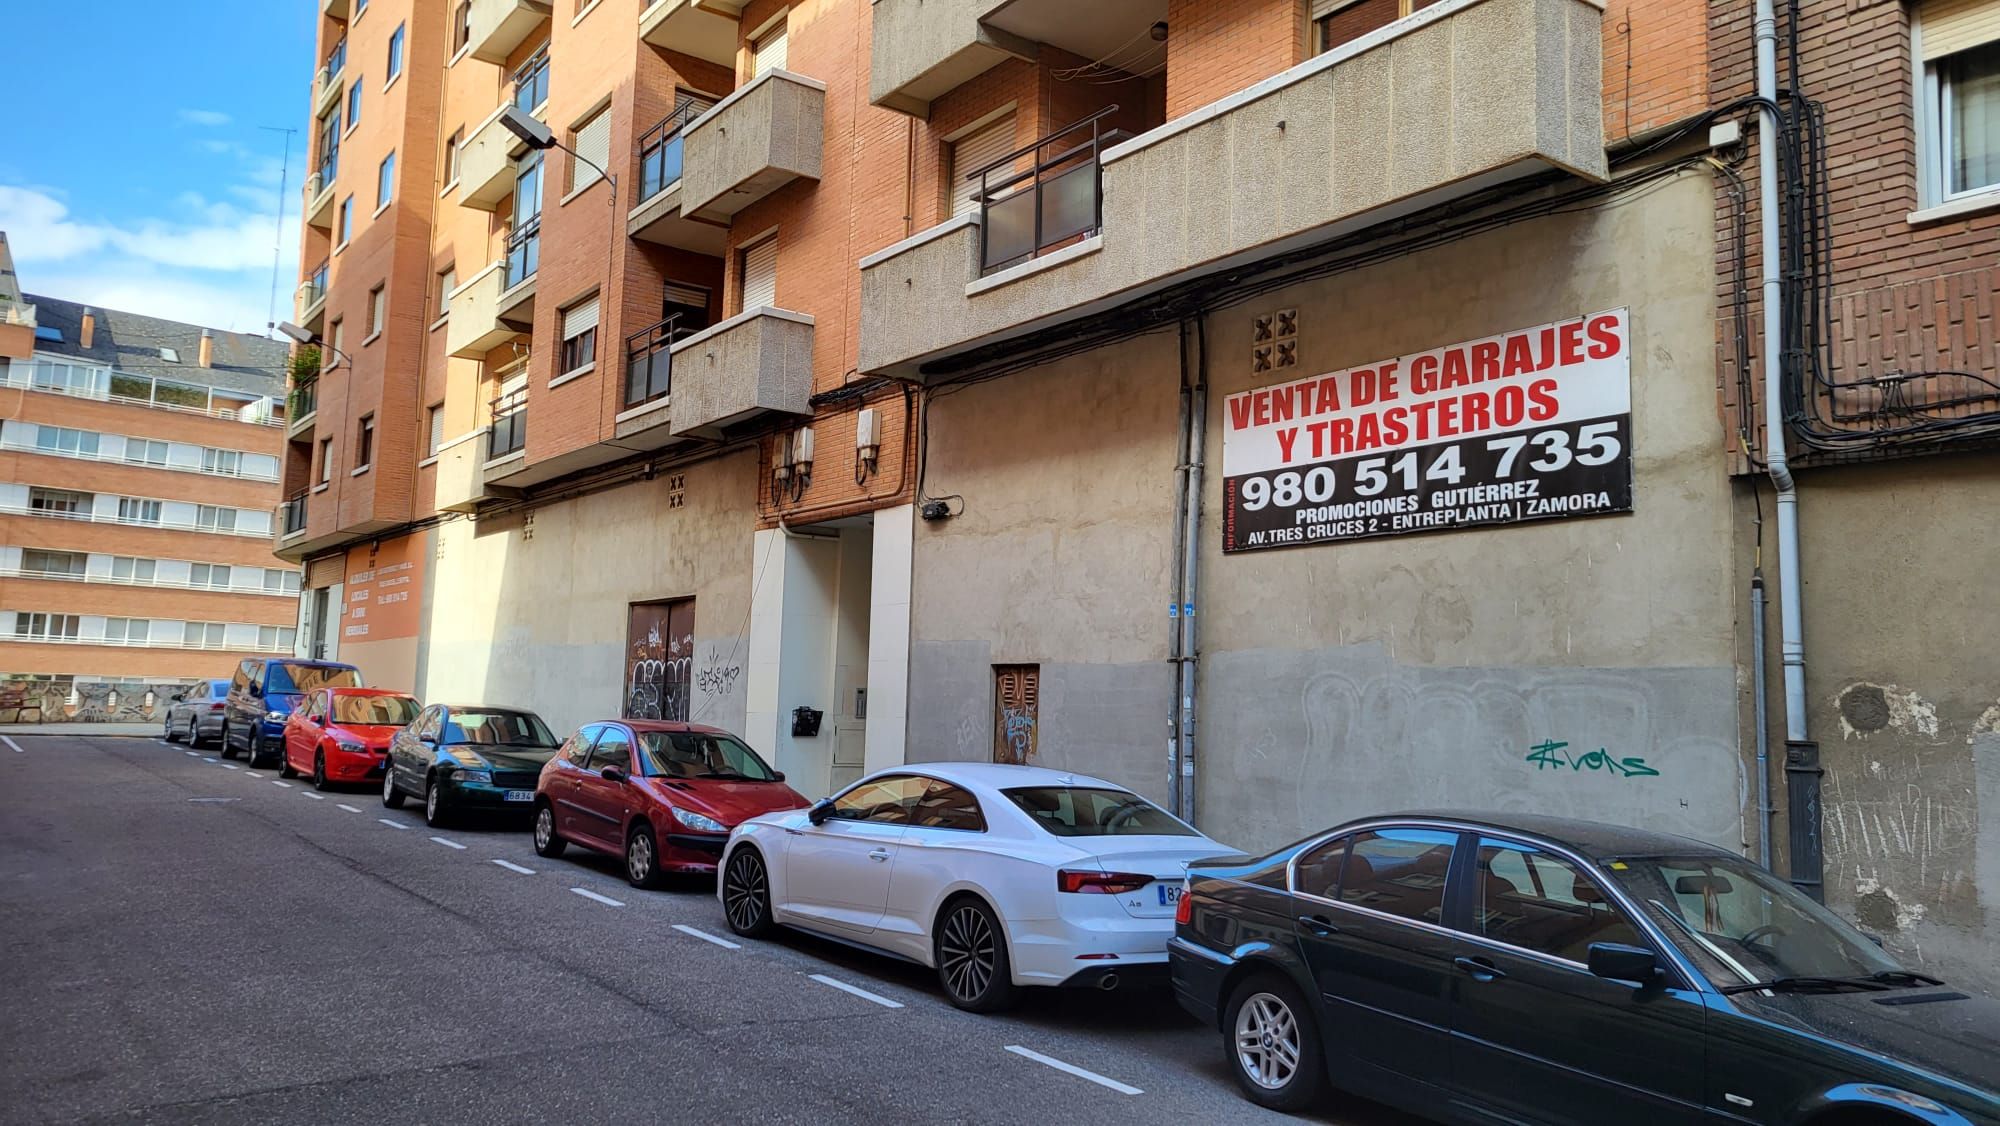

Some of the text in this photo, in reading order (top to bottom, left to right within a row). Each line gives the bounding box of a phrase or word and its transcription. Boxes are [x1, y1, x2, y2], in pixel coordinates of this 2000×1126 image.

[1229, 315, 1620, 431] VENTA DE GARAJES
[1276, 378, 1559, 464] Y TRASTEROS
[1241, 421, 1621, 511] 980 514 735
[1295, 479, 1539, 525] PROMOCIONES GUTIÉRREZ
[1307, 519, 1365, 538] CRUCES
[1368, 519, 1378, 532] 2
[1392, 503, 1511, 530] ENTREPLANTA
[1527, 491, 1611, 515] ZAMORA
